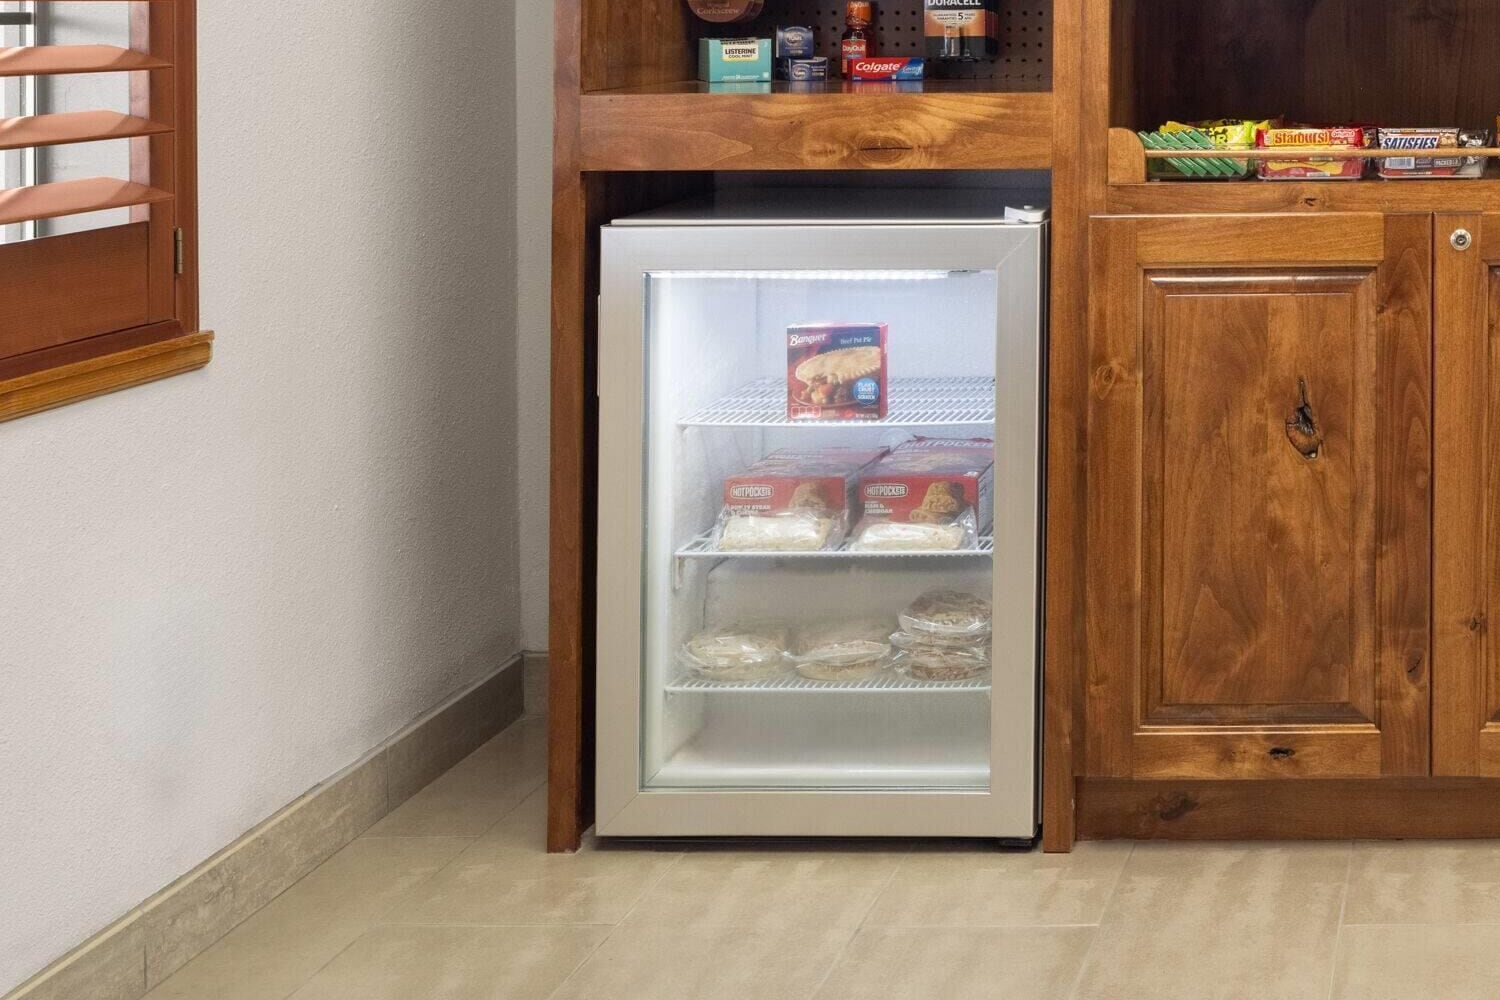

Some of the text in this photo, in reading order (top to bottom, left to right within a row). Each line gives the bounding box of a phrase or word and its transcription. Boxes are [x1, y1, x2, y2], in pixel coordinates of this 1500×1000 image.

[957, 12, 964, 21] 5
[855, 62, 900, 73] Colgate
[1274, 131, 1330, 145] Starburst
[1383, 137, 1437, 149] SATISFIES
[789, 333, 827, 346] Banquet
[731, 486, 772, 497] HOT POCKETS
[866, 485, 906, 496] HOT POCKETS
